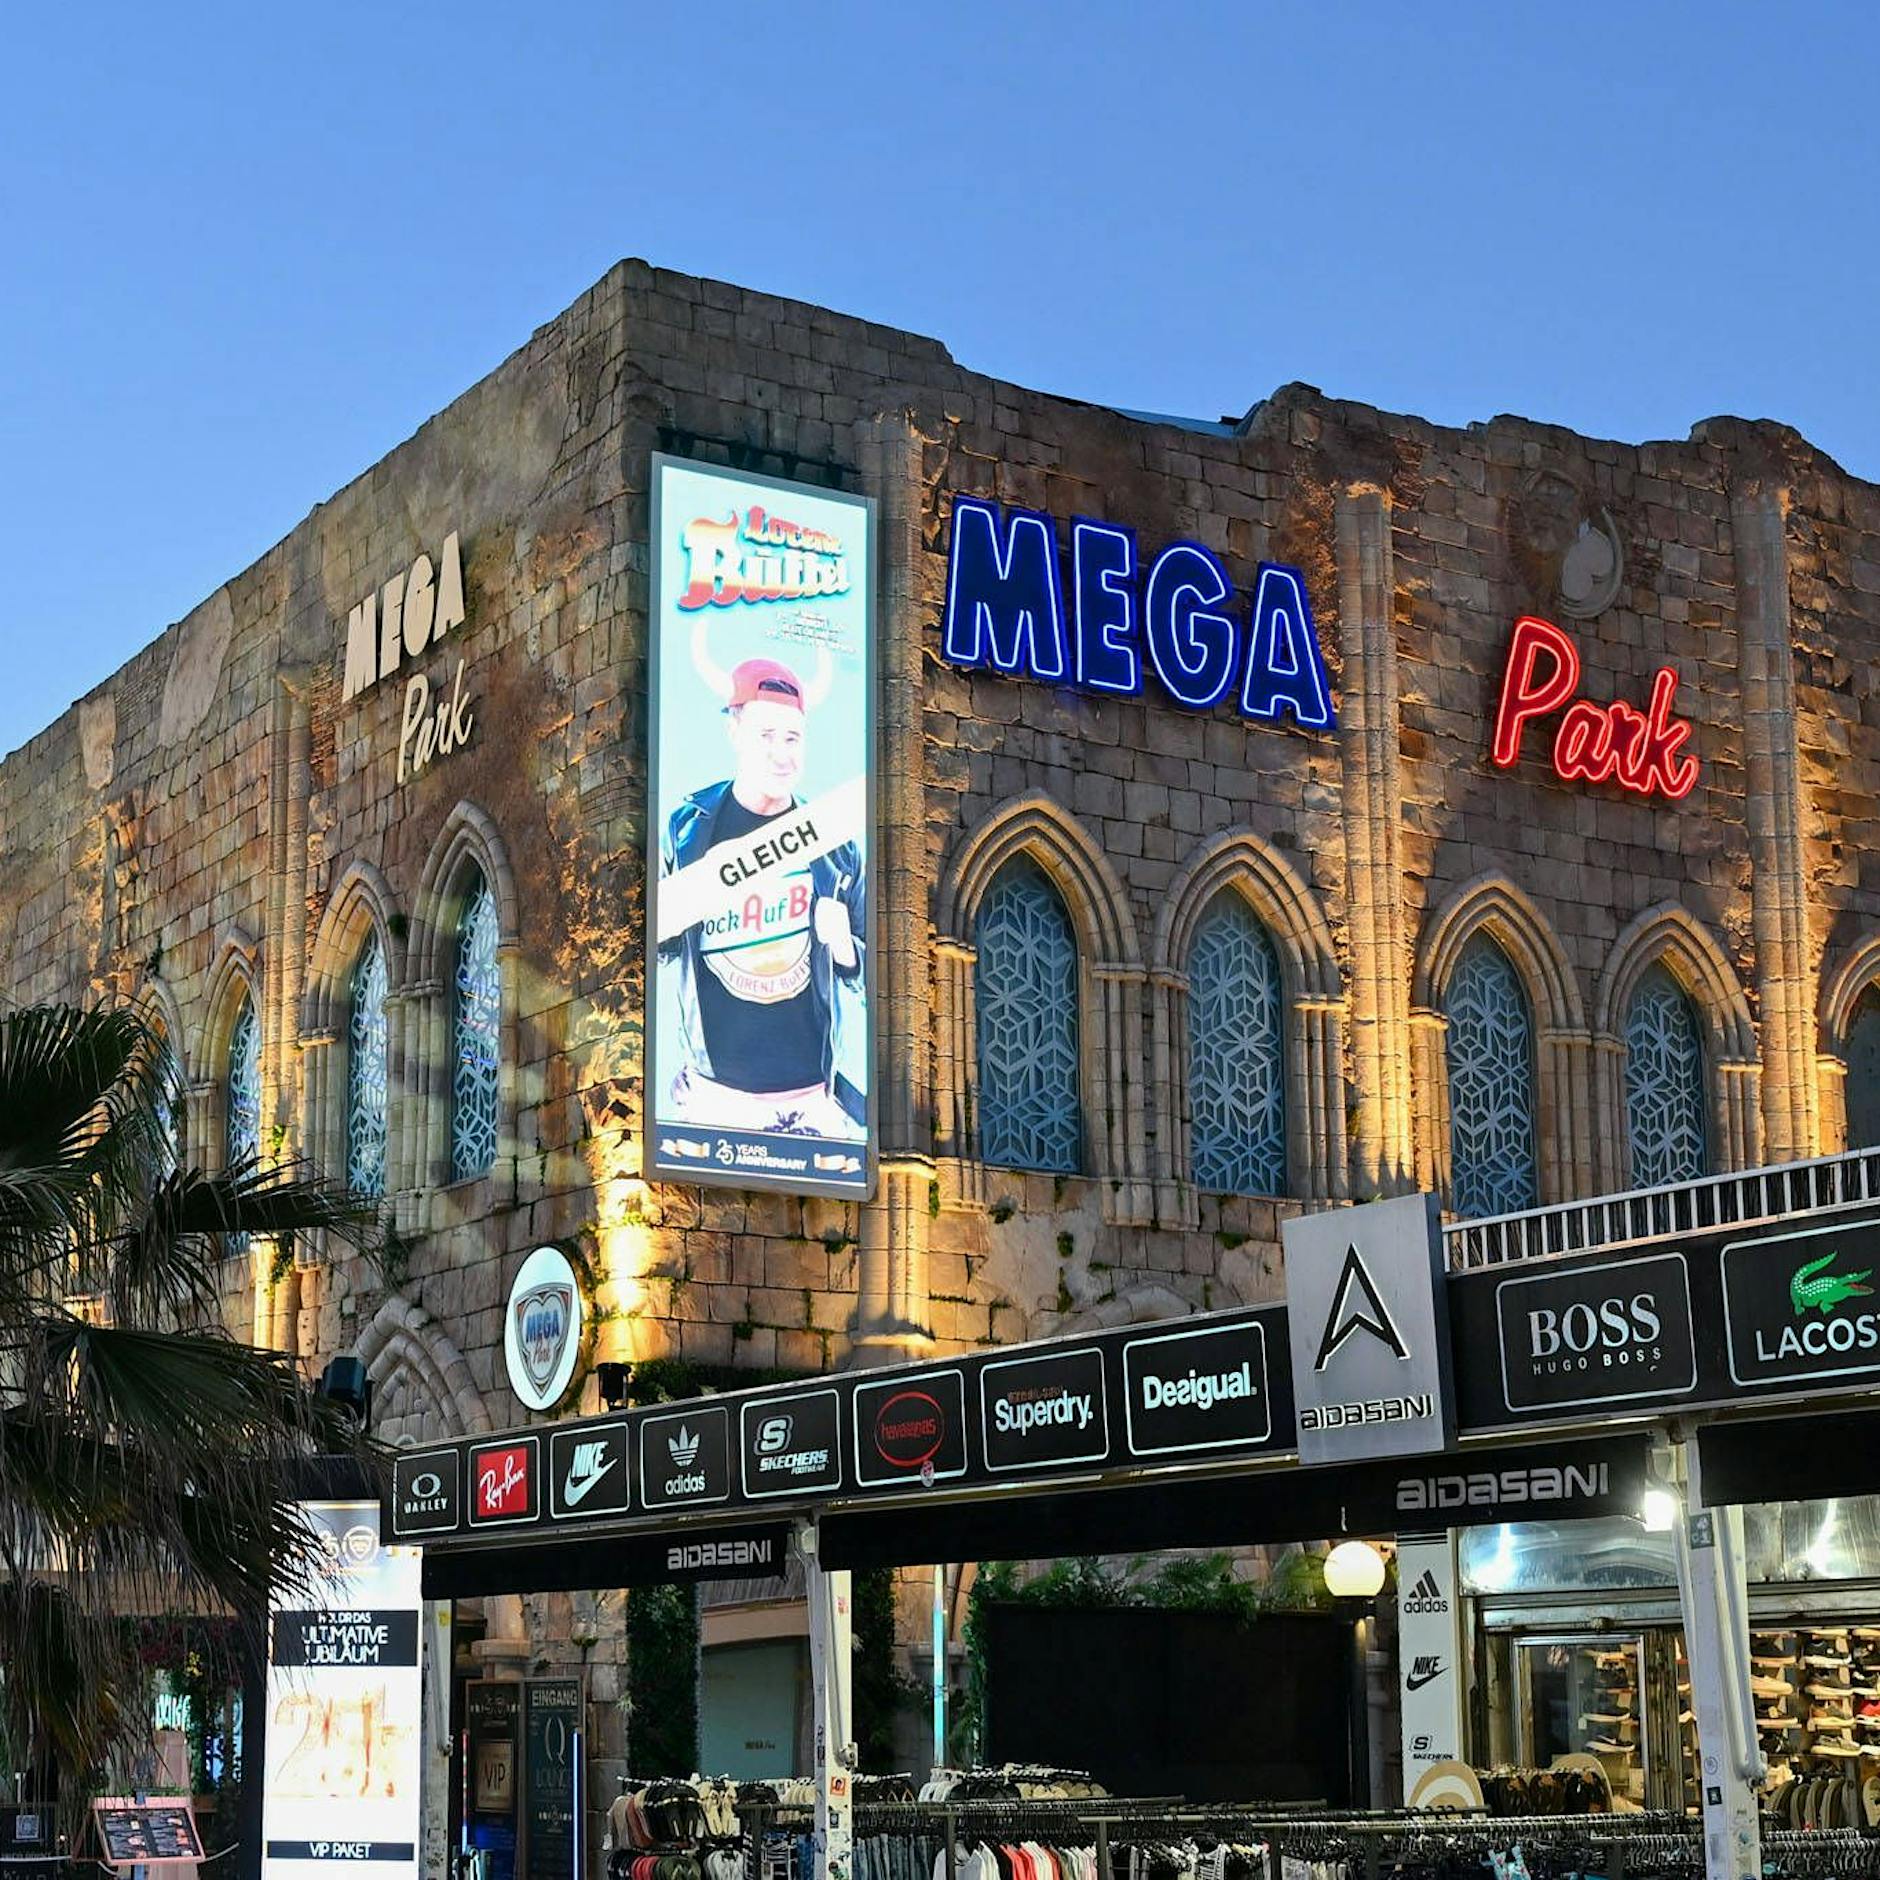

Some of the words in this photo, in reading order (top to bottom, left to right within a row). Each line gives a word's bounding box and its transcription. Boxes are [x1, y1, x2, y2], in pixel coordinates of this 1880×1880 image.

[342, 529, 465, 702] MEGA
[942, 494, 1337, 731] MEGA
[397, 659, 473, 783] Park
[1493, 615, 1701, 799] Park
[719, 819, 819, 887] GLEICH
[525, 1310, 561, 1343] MEGA
[1527, 1294, 1662, 1357] BOSS
[1755, 1313, 1880, 1362] LACOS
[1532, 1357, 1589, 1376] HUGO
[1603, 1346, 1662, 1367] BOSS
[572, 1440, 609, 1477] NIKE
[759, 1449, 829, 1472] SKECHERS
[665, 1471, 705, 1495] adidas
[1403, 1597, 1449, 1614] adidas
[1412, 1656, 1440, 1675] NIKE
[531, 1688, 578, 1707] EINGANG
[484, 1763, 505, 1791] VIP
[309, 1842, 331, 1858] VIP
[332, 1843, 372, 1859] PAKET
